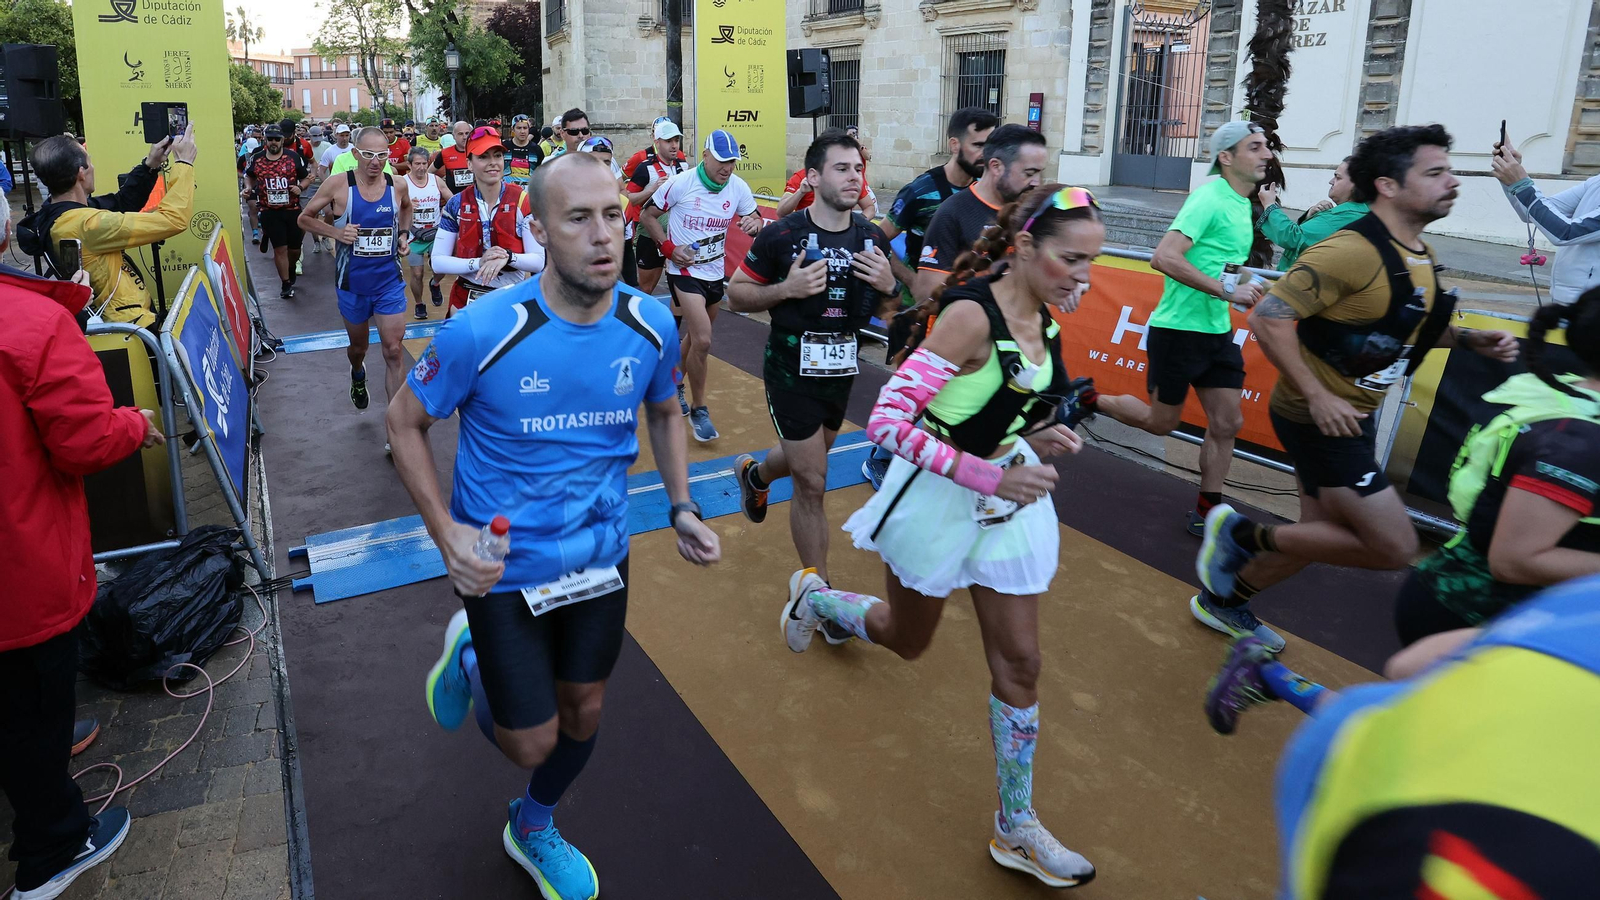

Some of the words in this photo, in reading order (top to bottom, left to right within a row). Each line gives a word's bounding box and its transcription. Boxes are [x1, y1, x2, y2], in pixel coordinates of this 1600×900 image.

[143, 0, 201, 11] Diputación
[1293, 0, 1346, 15] AZAR
[143, 14, 157, 25] de
[161, 14, 192, 25] Cádiz
[737, 26, 773, 36] Diputación
[737, 37, 746, 45] de
[748, 37, 767, 46] Cádiz
[1290, 32, 1327, 48] REZ
[163, 50, 190, 58] JEREZ
[184, 60, 192, 82] WINES
[726, 110, 759, 122] HSN
[734, 163, 763, 171] ALPERS
[265, 175, 288, 190] LEÃO
[191, 212, 219, 228] VALDESPIN
[706, 217, 732, 228] QUIJOT
[366, 236, 383, 247] 148
[707, 243, 717, 254] 82
[150, 263, 198, 272] CVIJERE
[828, 259, 849, 267] RAIL
[820, 344, 846, 360] 145
[1088, 349, 1109, 363] WE
[1115, 357, 1146, 372] ARE
[519, 370, 551, 391] als
[520, 407, 634, 434] TROTASIERRA
